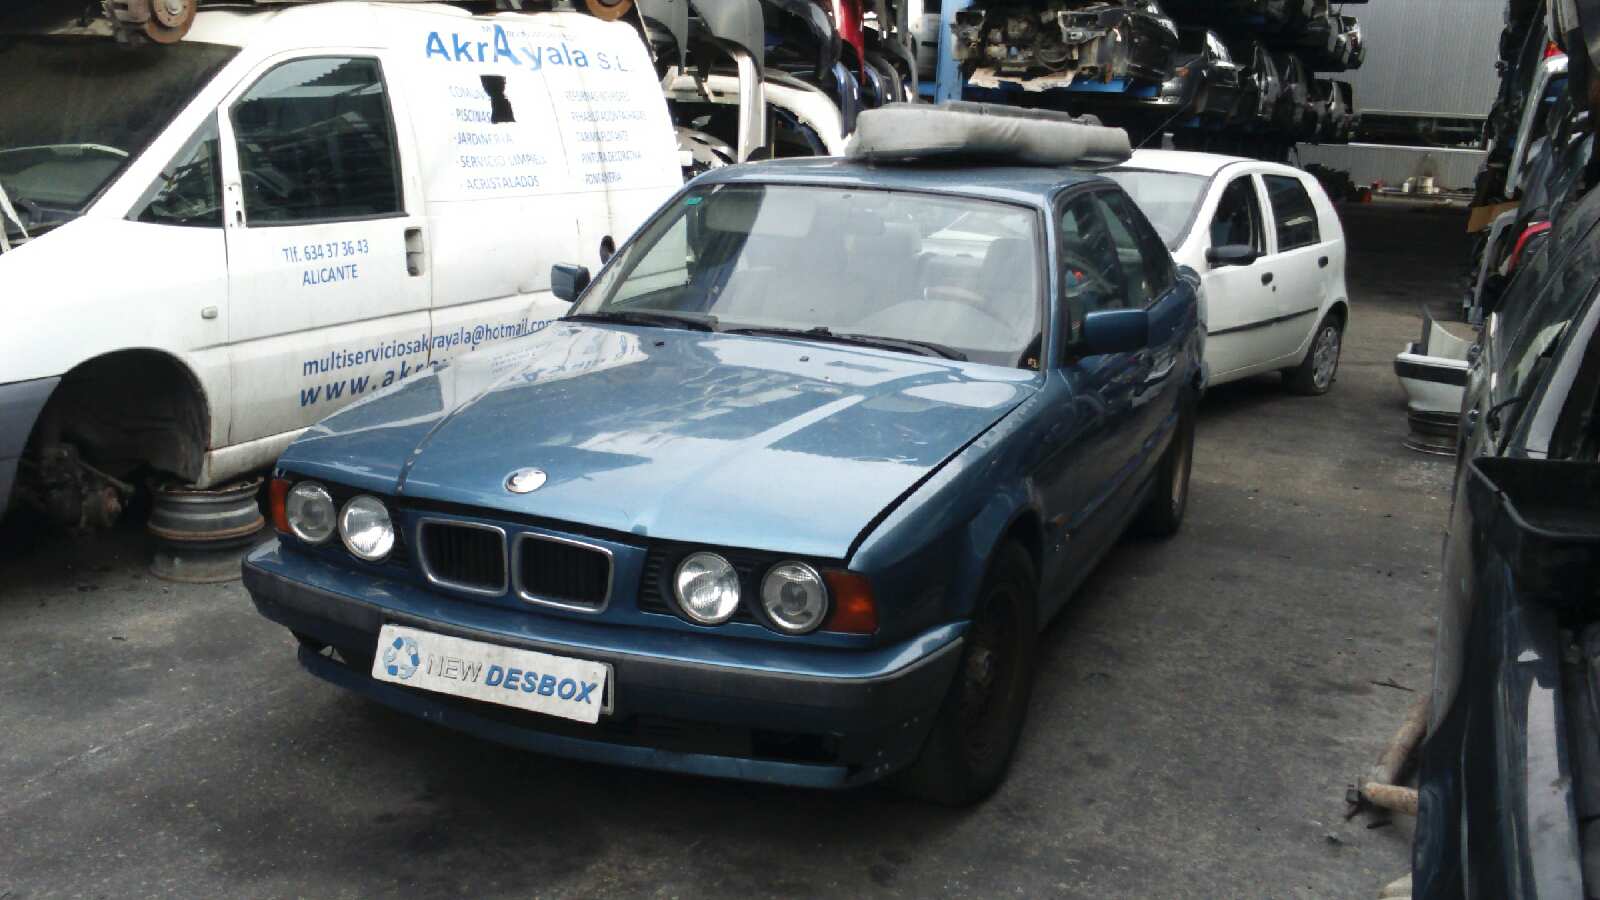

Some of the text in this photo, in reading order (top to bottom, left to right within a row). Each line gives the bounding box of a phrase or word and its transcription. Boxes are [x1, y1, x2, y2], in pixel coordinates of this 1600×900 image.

[425, 24, 590, 71] AkrAyala
[304, 244, 323, 261] 634
[327, 242, 339, 258] 37
[342, 240, 355, 256] 36
[357, 239, 369, 254] 43
[302, 264, 358, 286] ALICANTE
[426, 653, 598, 704] NEW DESBOX
